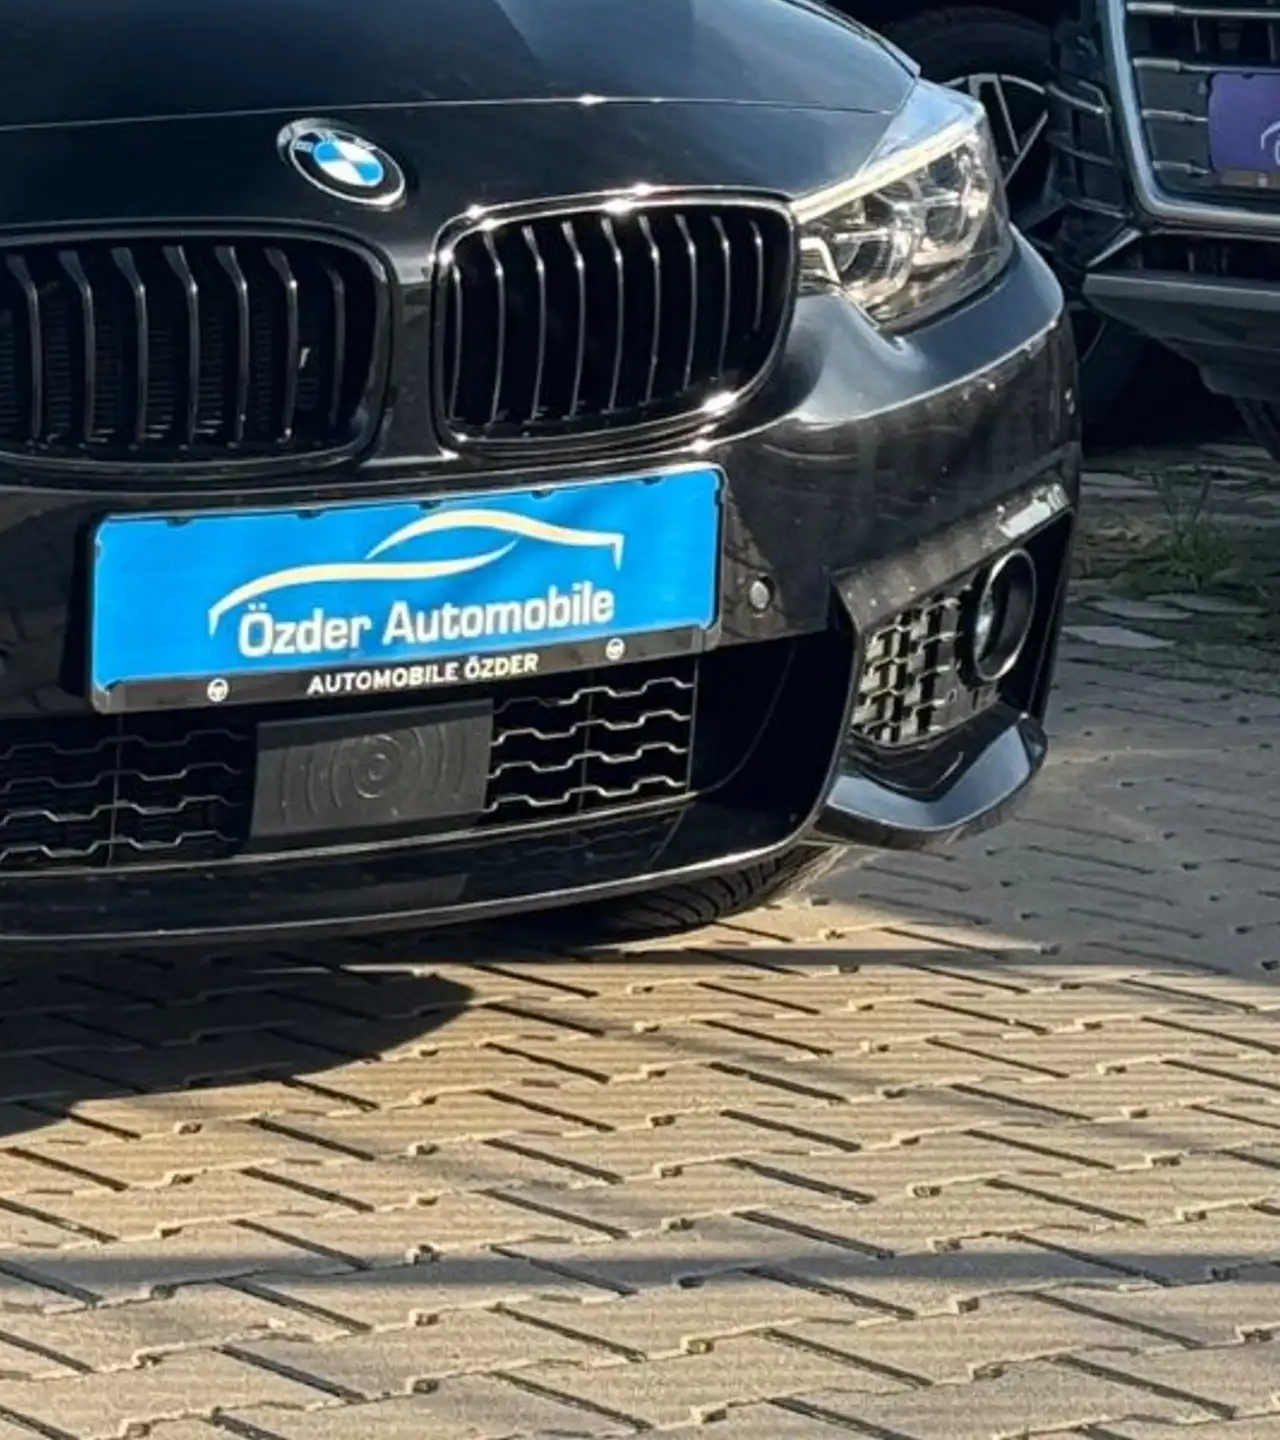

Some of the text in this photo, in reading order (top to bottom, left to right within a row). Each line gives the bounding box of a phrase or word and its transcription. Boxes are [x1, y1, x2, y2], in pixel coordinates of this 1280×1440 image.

[240, 581, 614, 658] Özder Automobile
[306, 652, 539, 696] AUTOMOBILE ÖZDER
